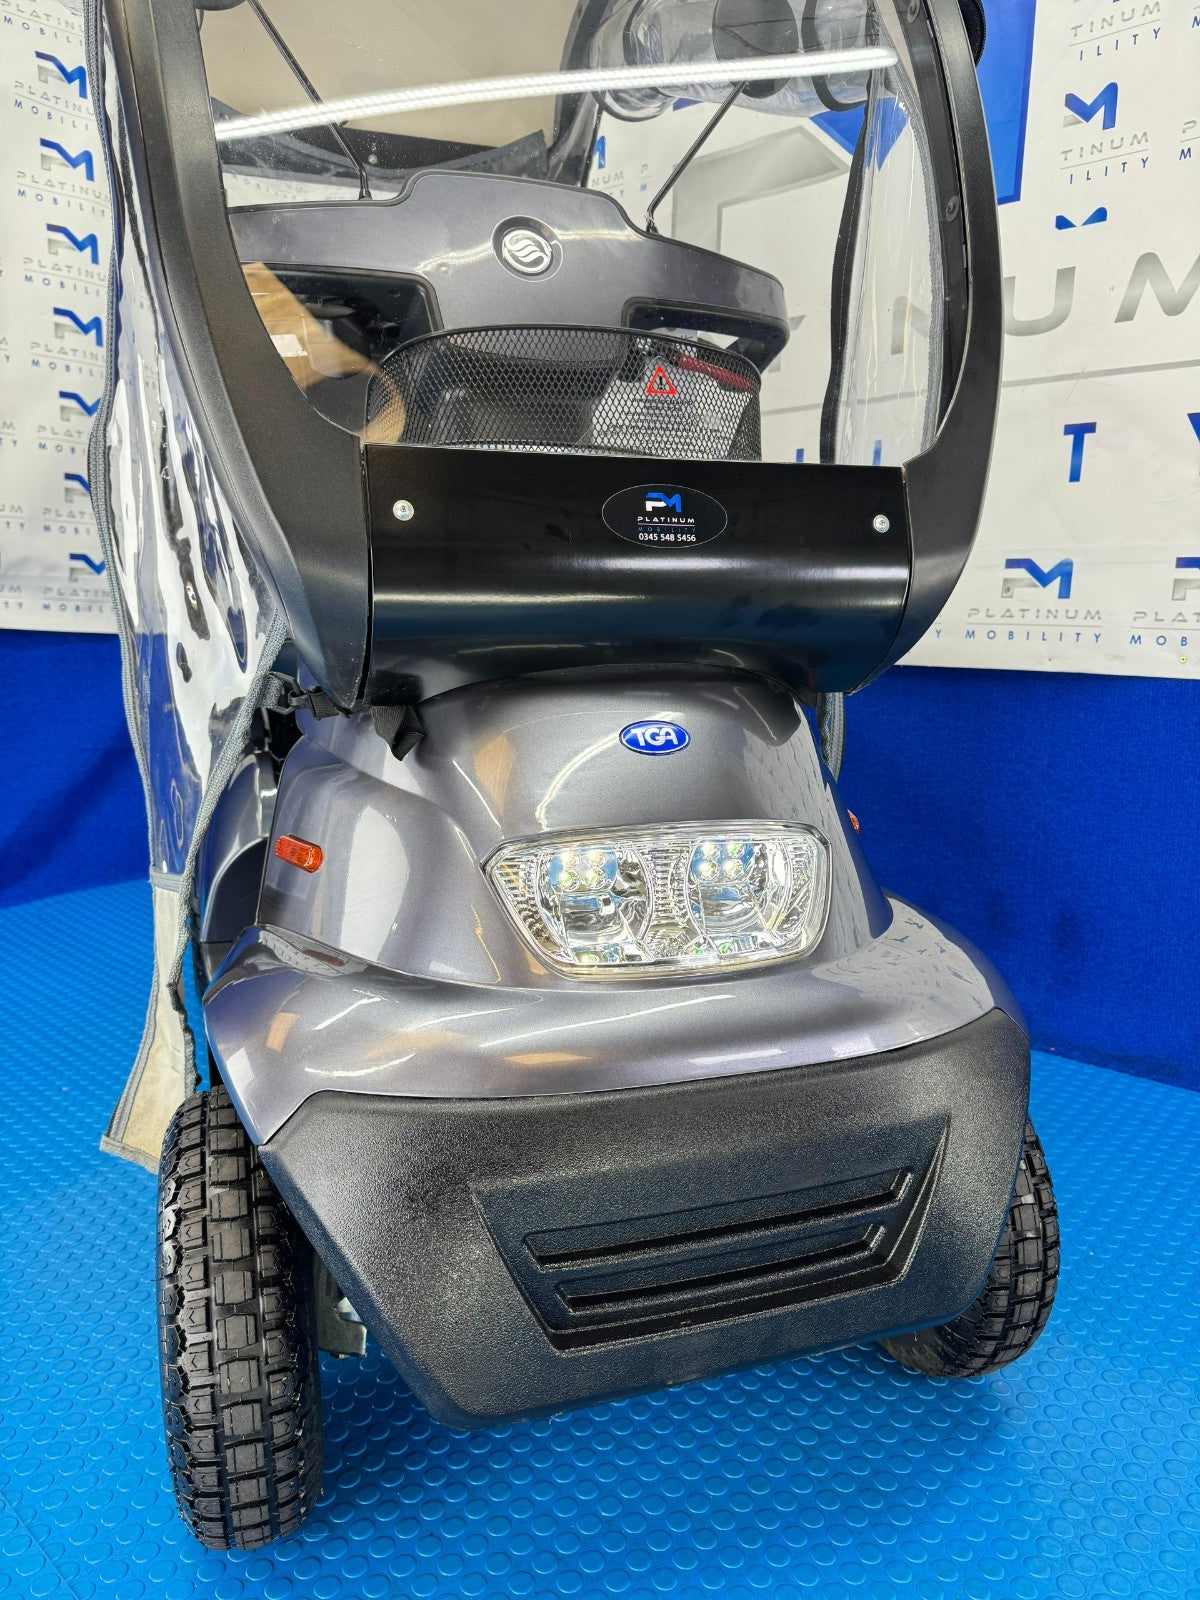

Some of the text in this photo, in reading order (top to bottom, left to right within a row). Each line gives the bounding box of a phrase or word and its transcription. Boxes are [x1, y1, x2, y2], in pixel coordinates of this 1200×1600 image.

[638, 532, 697, 542] 0345 548 5456
[967, 607, 1102, 621] PLATINUM
[964, 630, 1102, 644] MOBILITY
[630, 727, 679, 747] TGA
